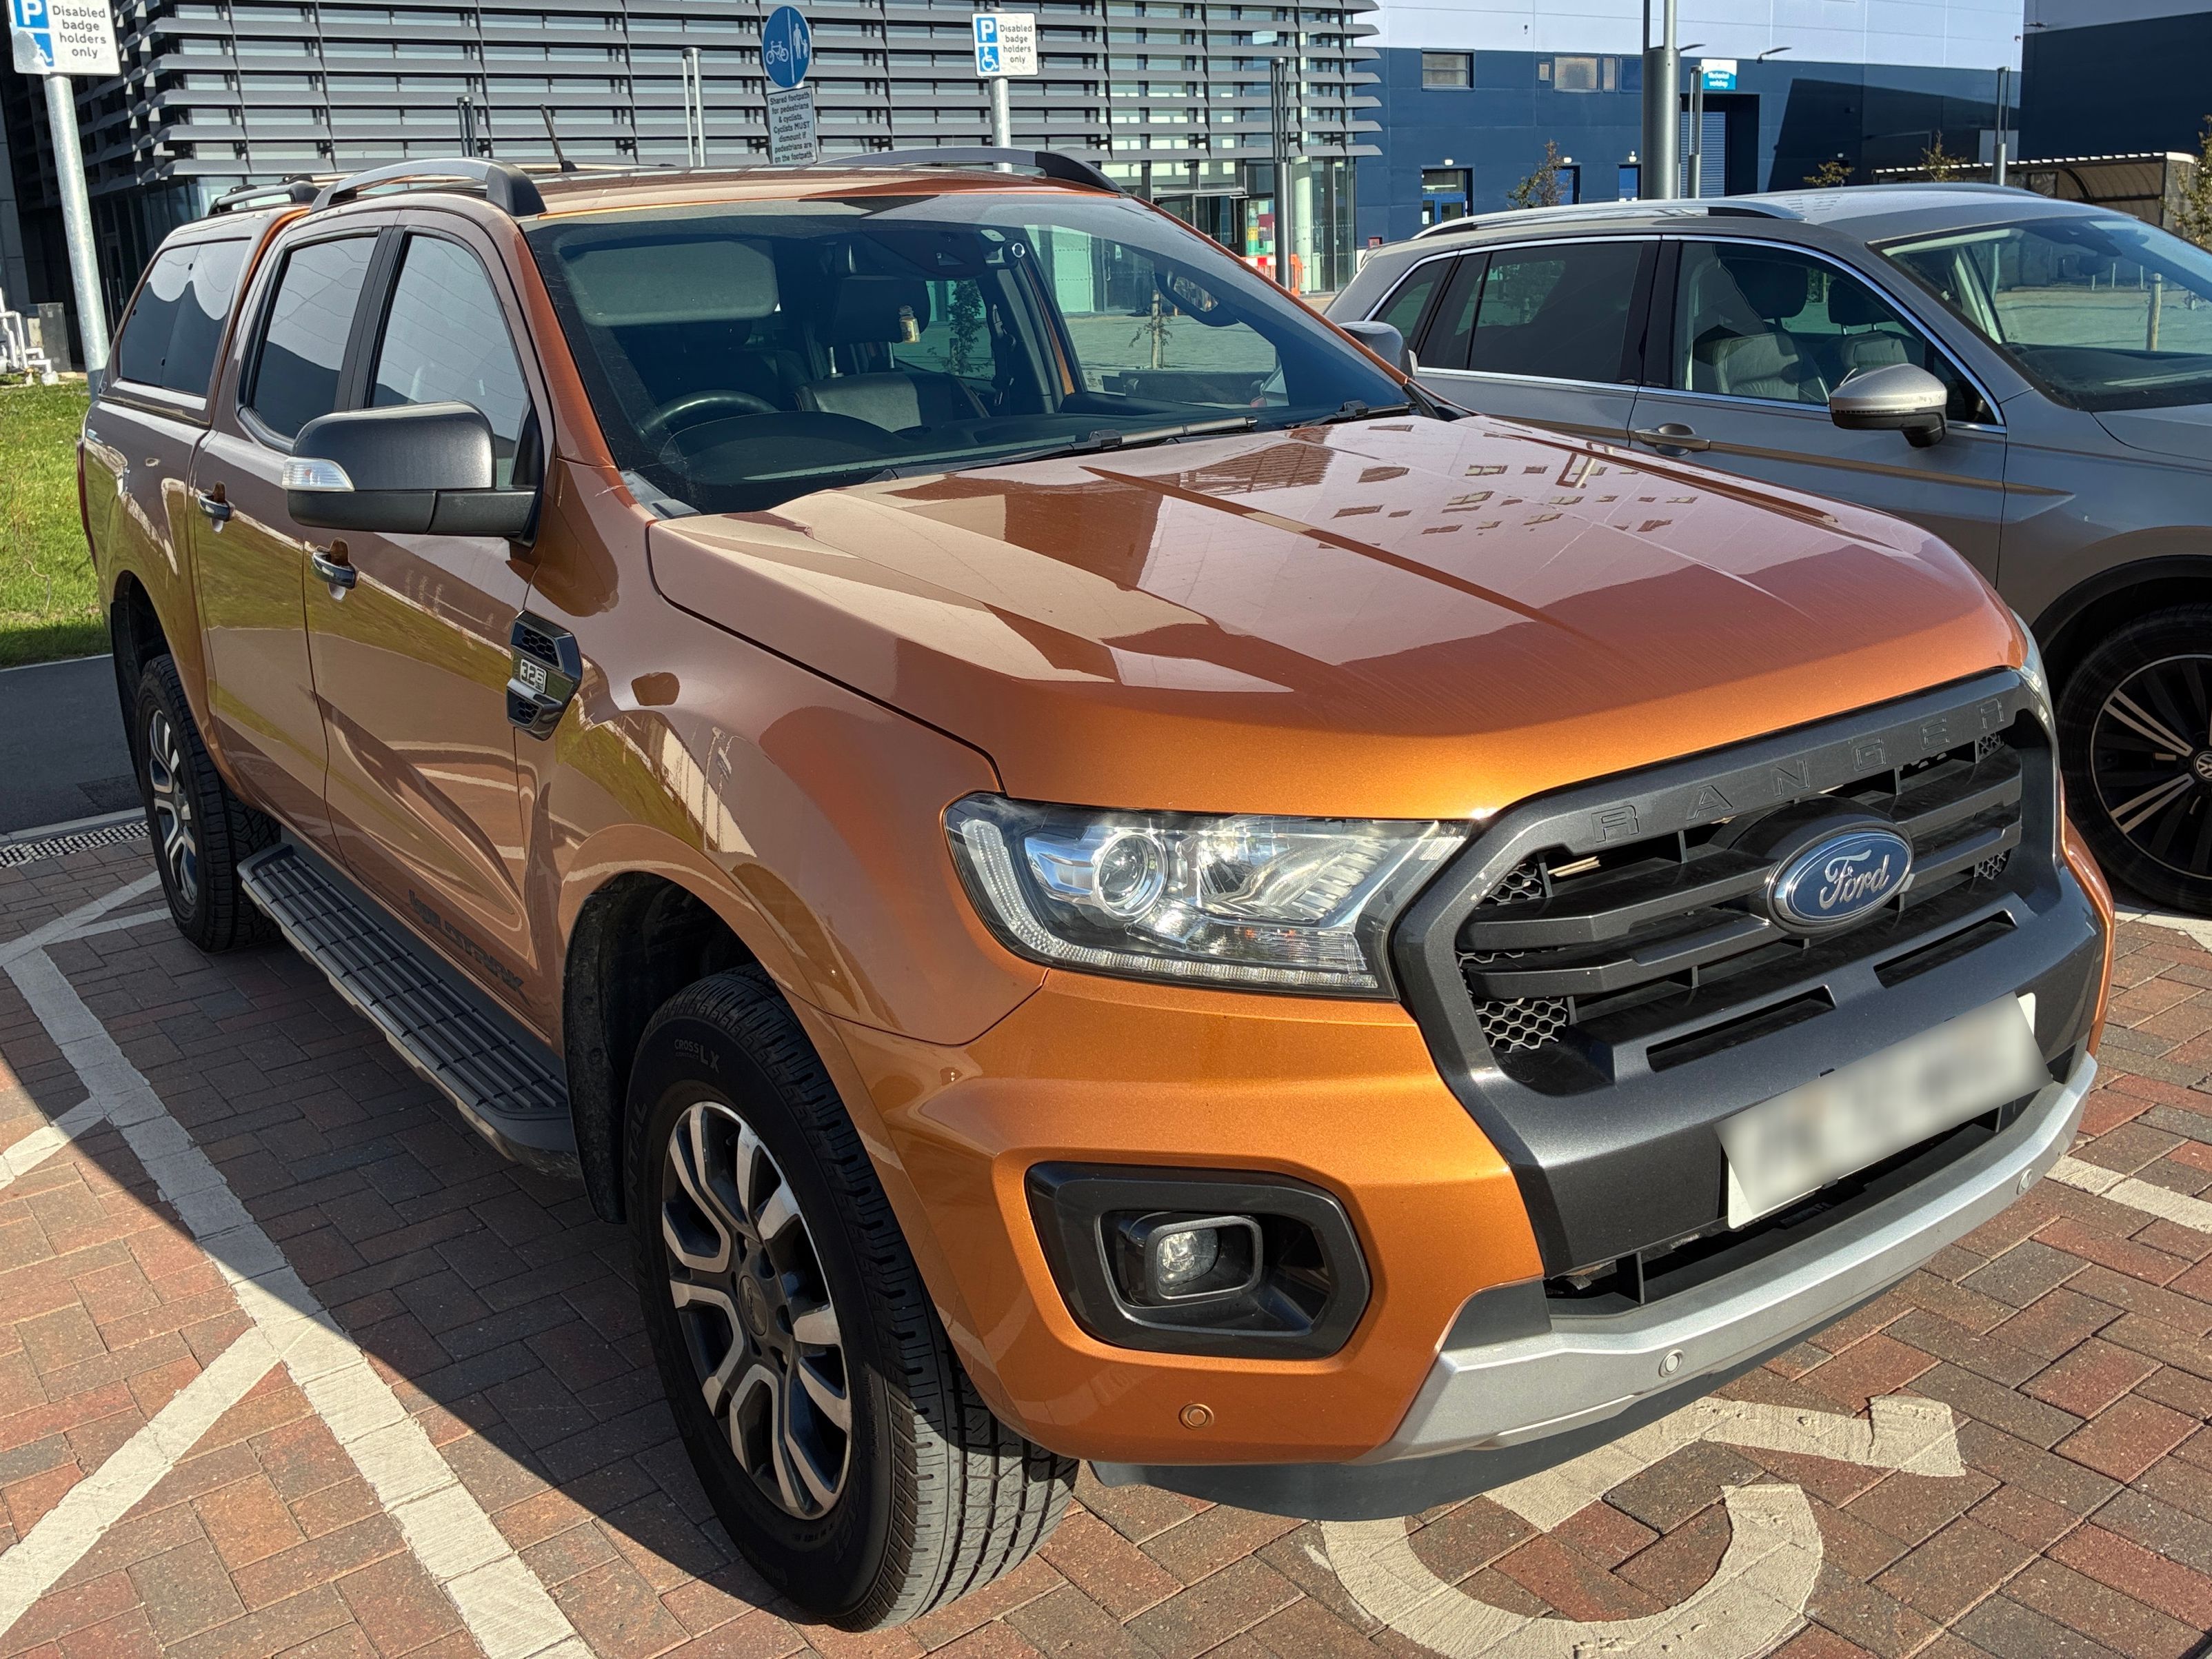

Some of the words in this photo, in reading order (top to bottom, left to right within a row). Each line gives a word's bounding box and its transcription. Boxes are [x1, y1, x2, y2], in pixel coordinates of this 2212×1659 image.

[21, 0, 43, 25] P
[52, 6, 105, 18] Disabled
[62, 19, 99, 32] badge
[981, 20, 994, 41] P
[1000, 24, 1032, 32] Disabled
[59, 32, 106, 44] holders
[1005, 34, 1028, 43] badge
[72, 47, 98, 59] only
[1009, 55, 1025, 64] only
[770, 95, 787, 105] Shared
[788, 92, 810, 102] footpath
[781, 103, 809, 114] pedestrians
[774, 125, 793, 134] Cyclists
[794, 121, 810, 130] MUST
[778, 133, 801, 143] dismount
[774, 144, 803, 154] pedestrians
[1590, 698, 2005, 843] RANGER
[1819, 849, 1890, 910] Ford
[674, 1038, 699, 1054] CROSS
[700, 1045, 720, 1074] LX
